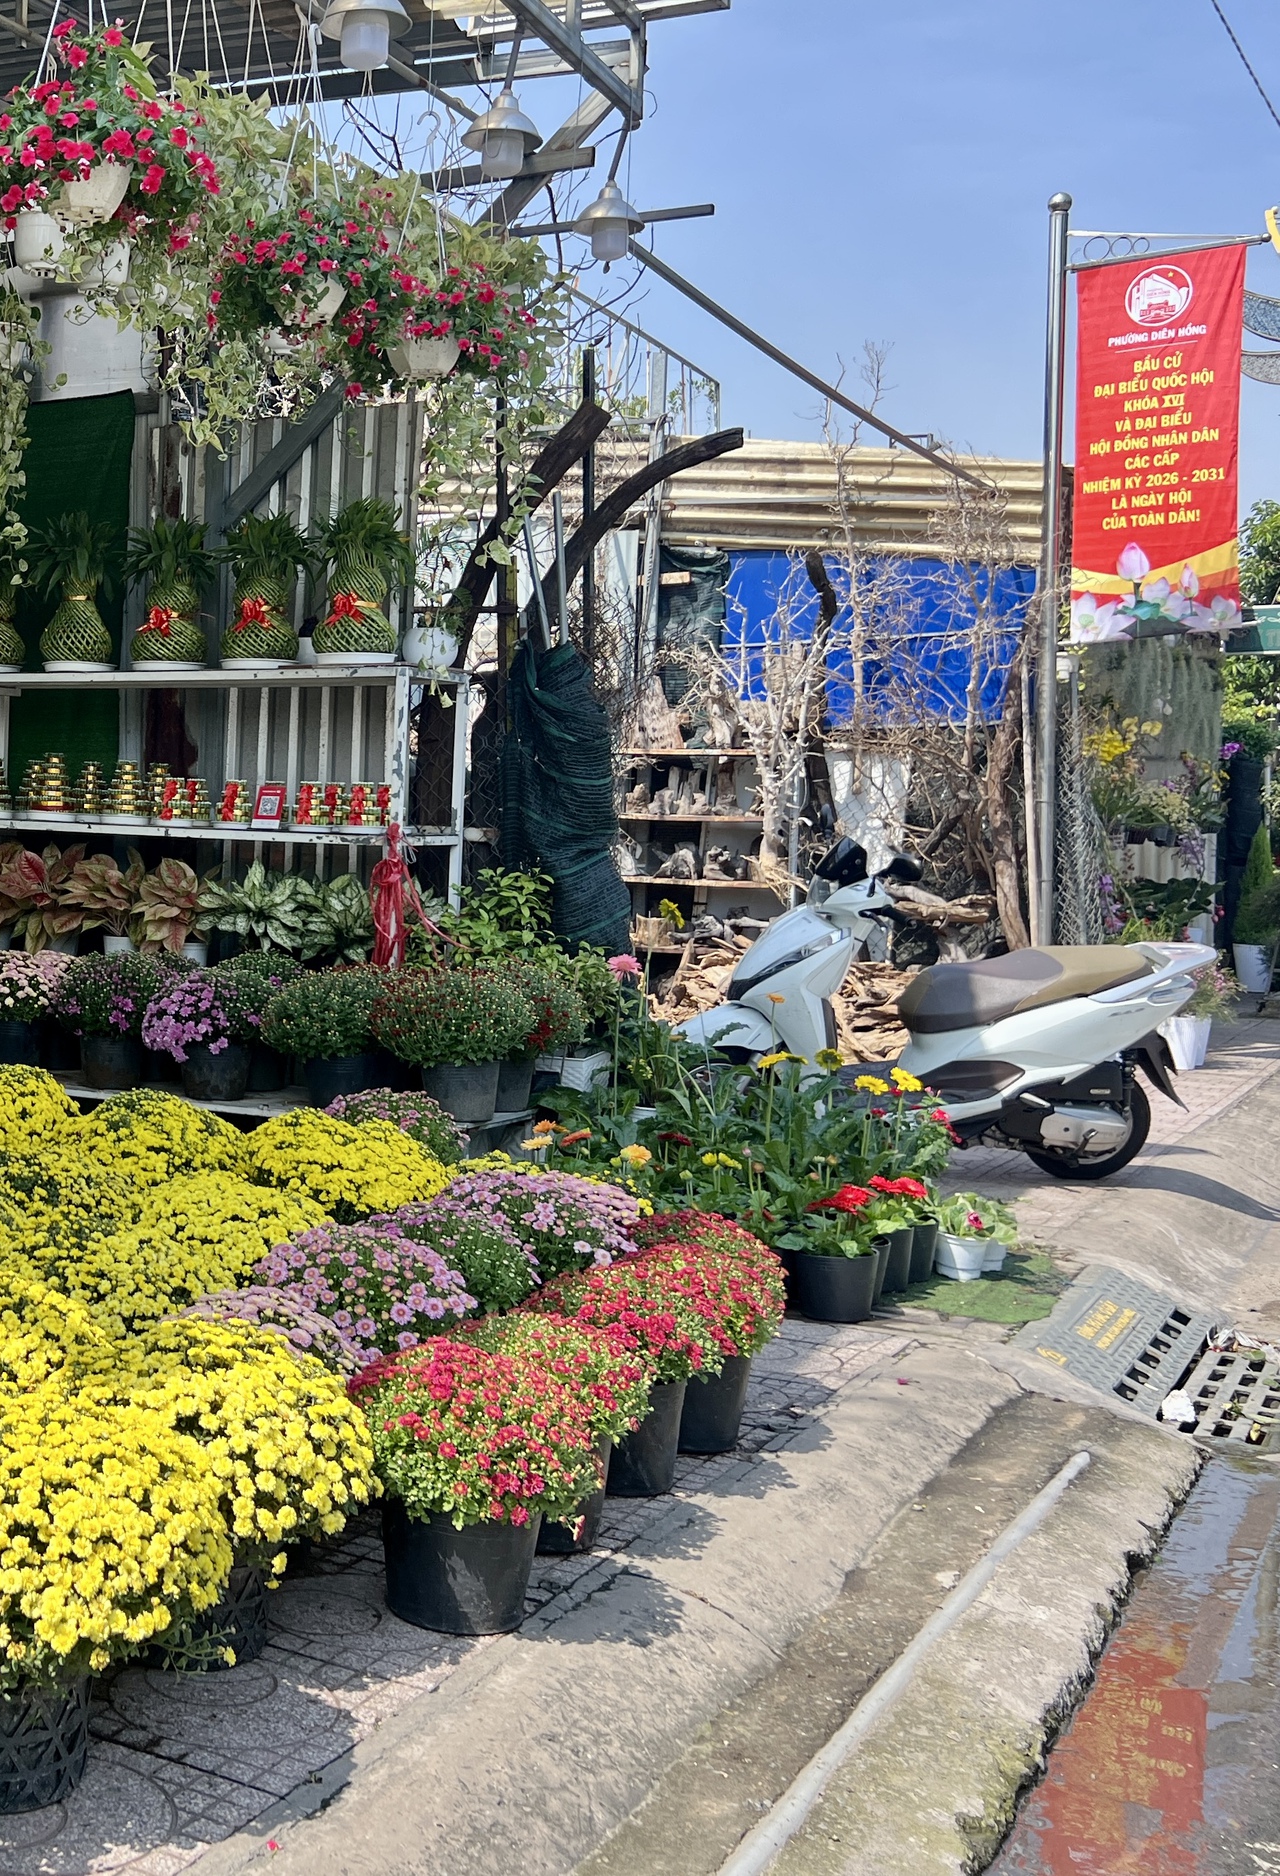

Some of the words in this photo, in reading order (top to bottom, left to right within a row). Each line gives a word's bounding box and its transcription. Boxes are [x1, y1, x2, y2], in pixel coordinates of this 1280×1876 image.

[1108, 332, 1148, 347] PHƯỜNG
[1151, 327, 1175, 341] DIÊN
[1163, 351, 1183, 369] CỬ
[1094, 383, 1115, 399] ĐẠI
[1118, 373, 1148, 394] BIỂU
[1151, 370, 1187, 391] QUỐC
[1190, 368, 1214, 386] HỘI
[1124, 395, 1159, 413] KHÓA
[1161, 393, 1185, 408] XVI
[1115, 416, 1131, 433] VÀ
[1135, 416, 1157, 432] ĐẠI
[1161, 406, 1192, 427] BIỂU
[1089, 438, 1111, 457] HỘI
[1114, 433, 1148, 452] ĐỒNG
[1151, 429, 1188, 448] NHÂN
[1191, 426, 1220, 443] DÂN
[1124, 453, 1150, 470] CÁC
[1153, 448, 1180, 467] CẤP
[1082, 476, 1121, 495] NHIỆM
[1125, 473, 1142, 489] KỲ
[1145, 472, 1179, 487] 2026
[1191, 467, 1225, 483] 2031
[1111, 494, 1127, 510] LÀ
[1131, 491, 1165, 508] NGÀY
[1168, 487, 1192, 506] HỘI
[1102, 512, 1127, 531] CỦA
[1130, 510, 1165, 527] TOÀN
[1168, 507, 1201, 524] DÂN!
